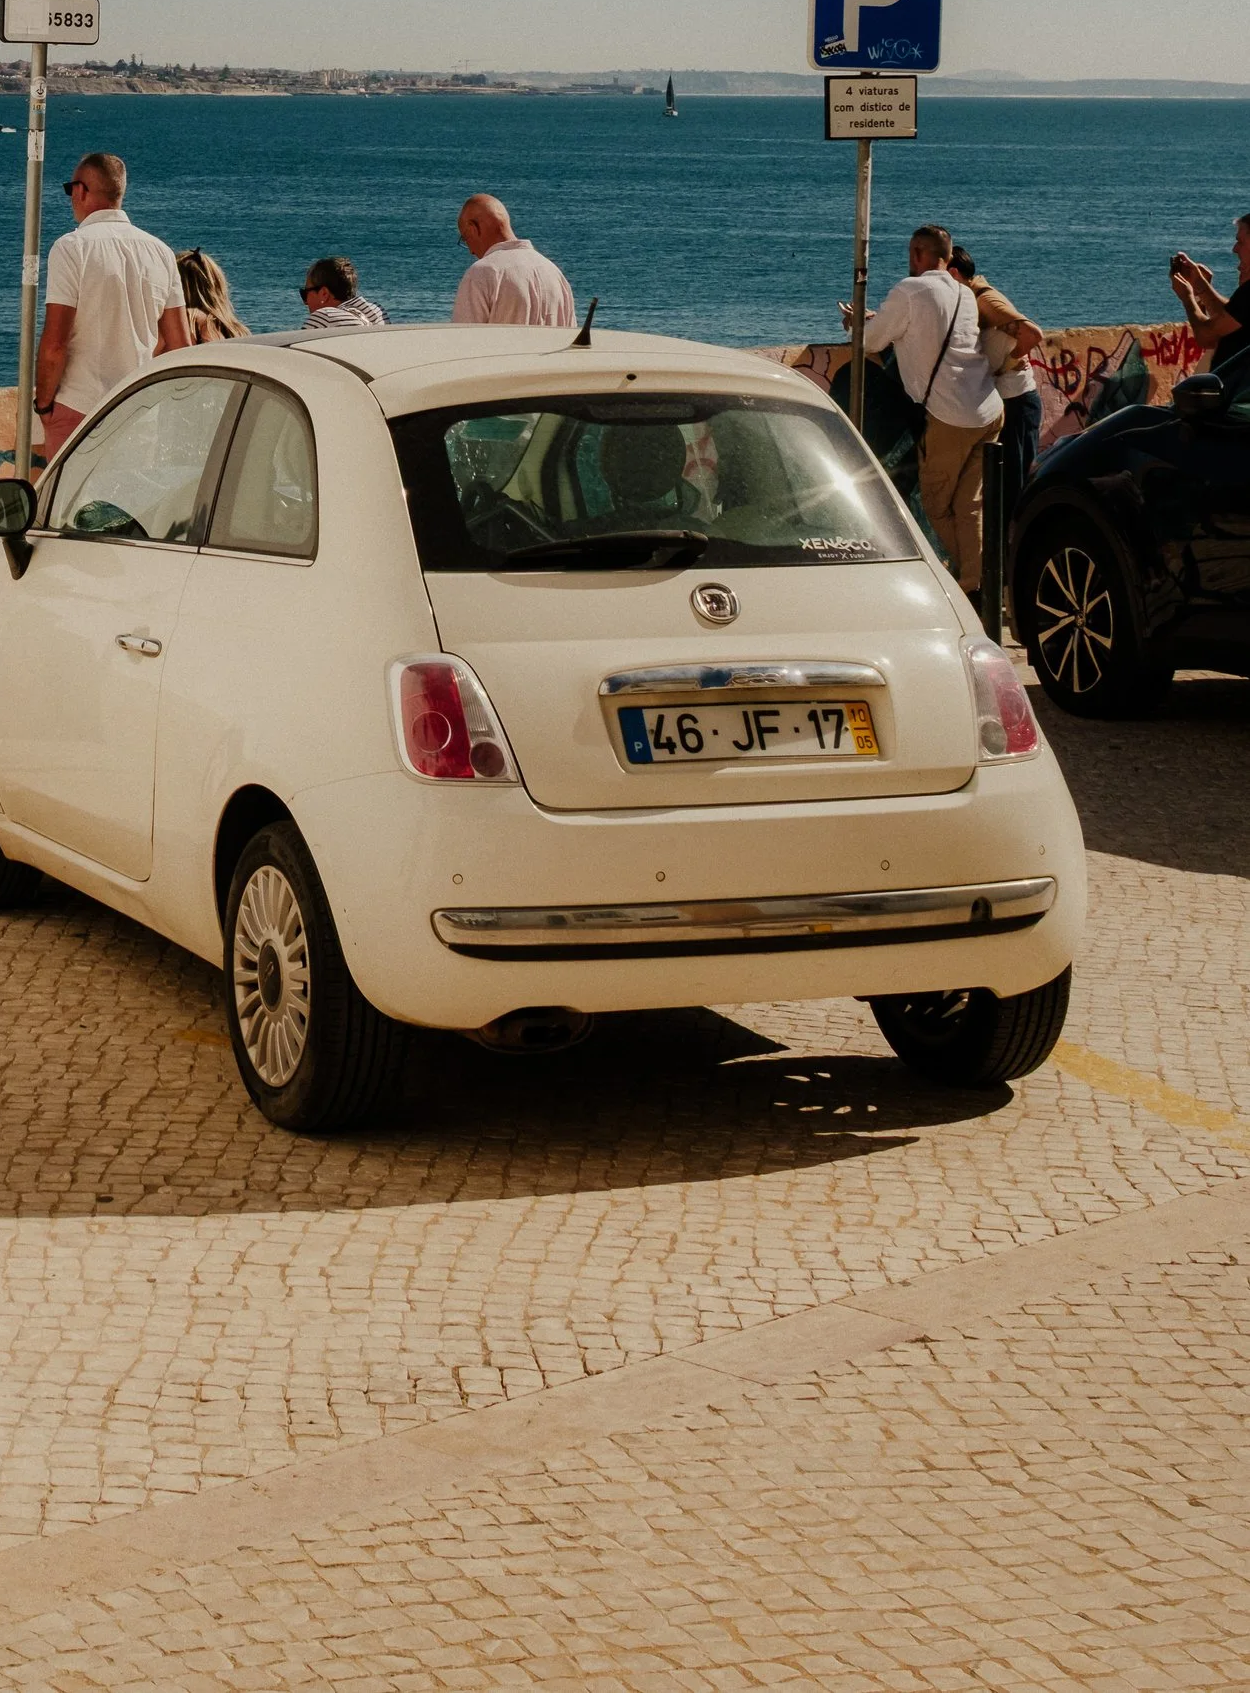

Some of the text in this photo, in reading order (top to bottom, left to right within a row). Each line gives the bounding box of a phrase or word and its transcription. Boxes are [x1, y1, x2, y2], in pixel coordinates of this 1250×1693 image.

[845, 86, 899, 96] 4 viaturas
[834, 104, 854, 113] com
[898, 102, 911, 112] de
[849, 118, 895, 128] residente
[850, 708, 867, 723] 10
[634, 741, 644, 753] P
[856, 735, 874, 749] 05
